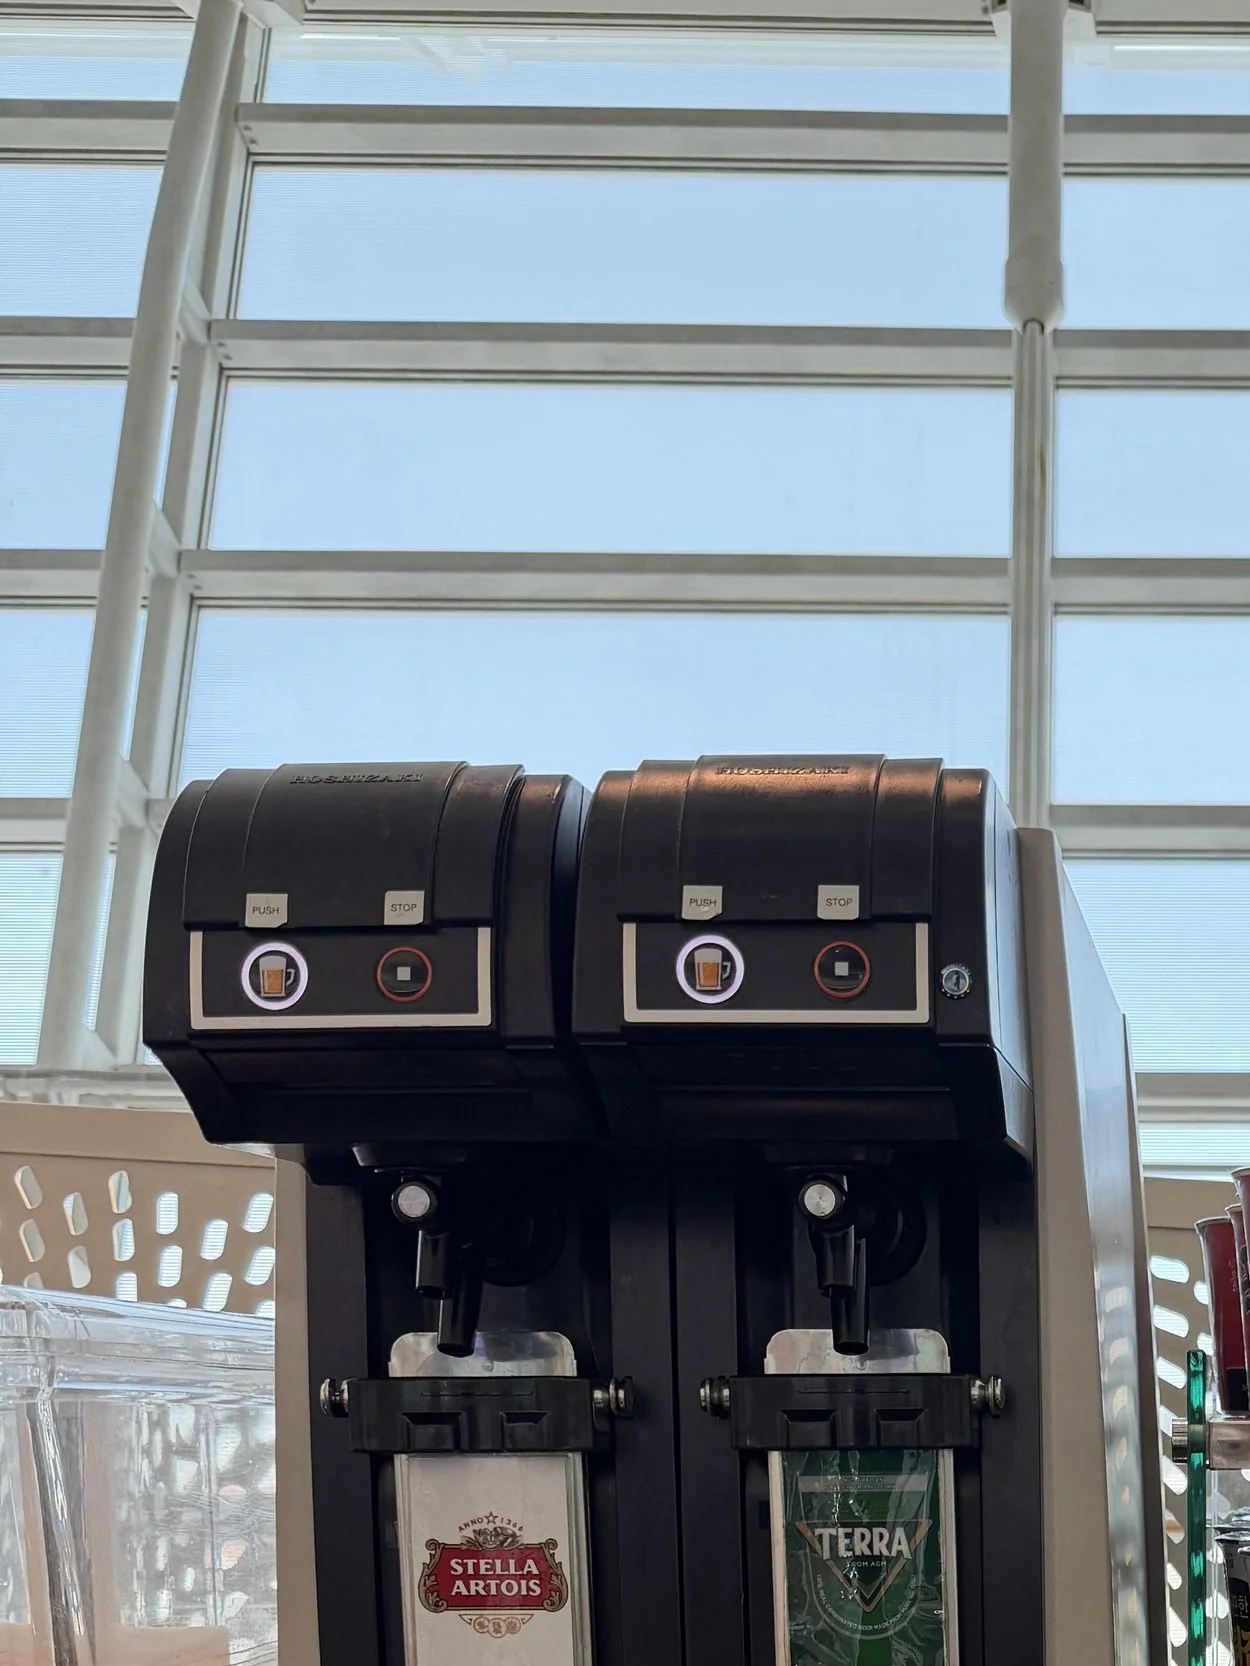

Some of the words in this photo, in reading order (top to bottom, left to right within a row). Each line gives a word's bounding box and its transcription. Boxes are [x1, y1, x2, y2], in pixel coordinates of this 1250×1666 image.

[715, 766, 850, 776] HOSHIZAKI
[289, 774, 424, 784] HOSHIZAKI
[390, 903, 417, 912] STOP
[689, 898, 717, 907] PUSH
[826, 898, 853, 907] STOP
[252, 905, 280, 915] PUSH
[458, 1517, 484, 1533] ANNO
[500, 1518, 524, 1532] 1366
[814, 1526, 912, 1560] TERRA
[450, 1558, 540, 1576] STELLA
[450, 1579, 542, 1596] ARTOIS
